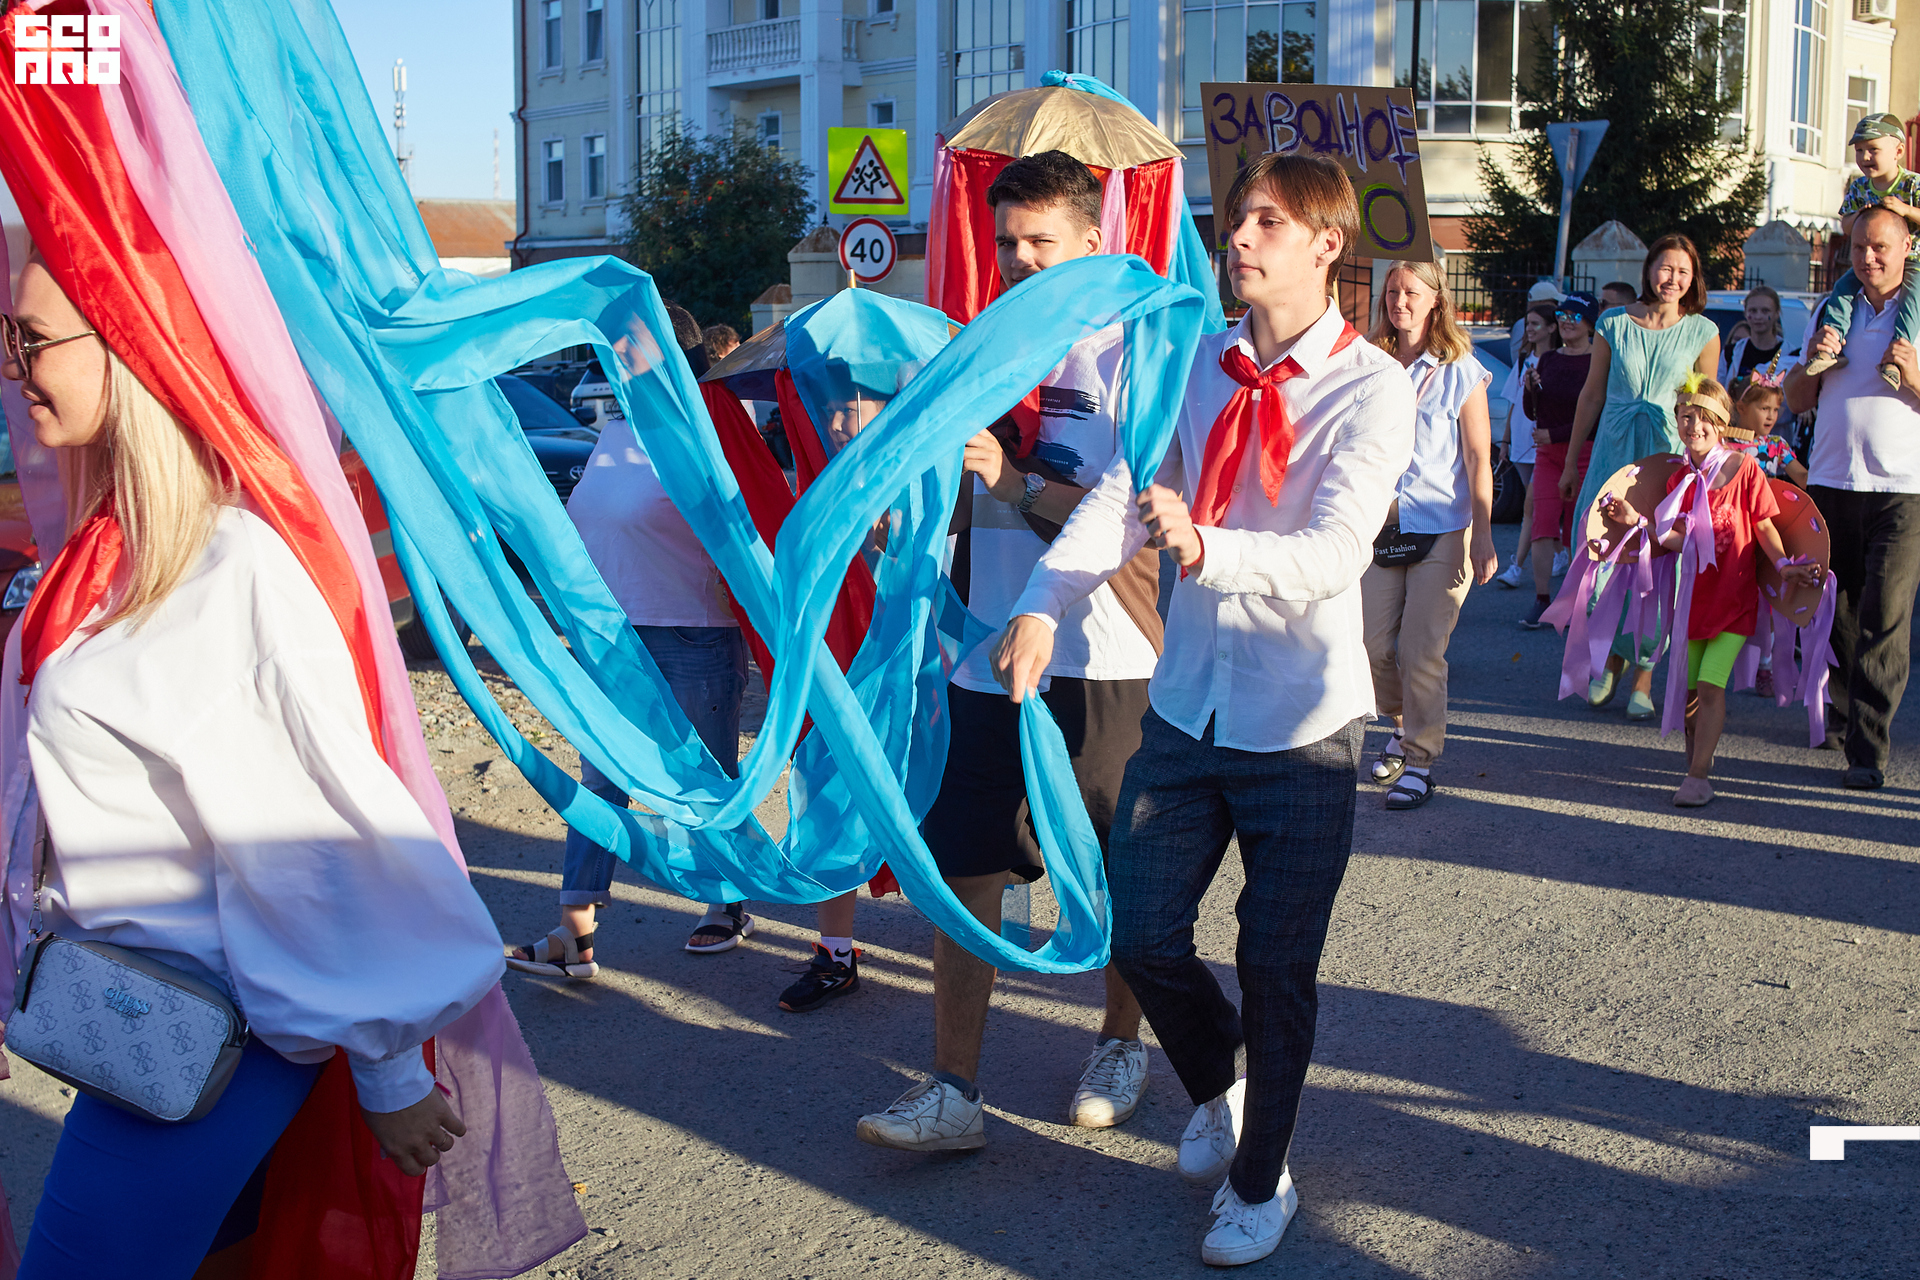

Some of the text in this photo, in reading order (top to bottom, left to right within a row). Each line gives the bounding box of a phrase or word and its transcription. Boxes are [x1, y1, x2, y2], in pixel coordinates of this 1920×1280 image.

[1210, 90, 1420, 186] ЗАВОДНОЕ
[850, 237, 884, 264] 40
[1374, 544, 1417, 555] Fast Fashion
[104, 987, 152, 1015] GUESS
